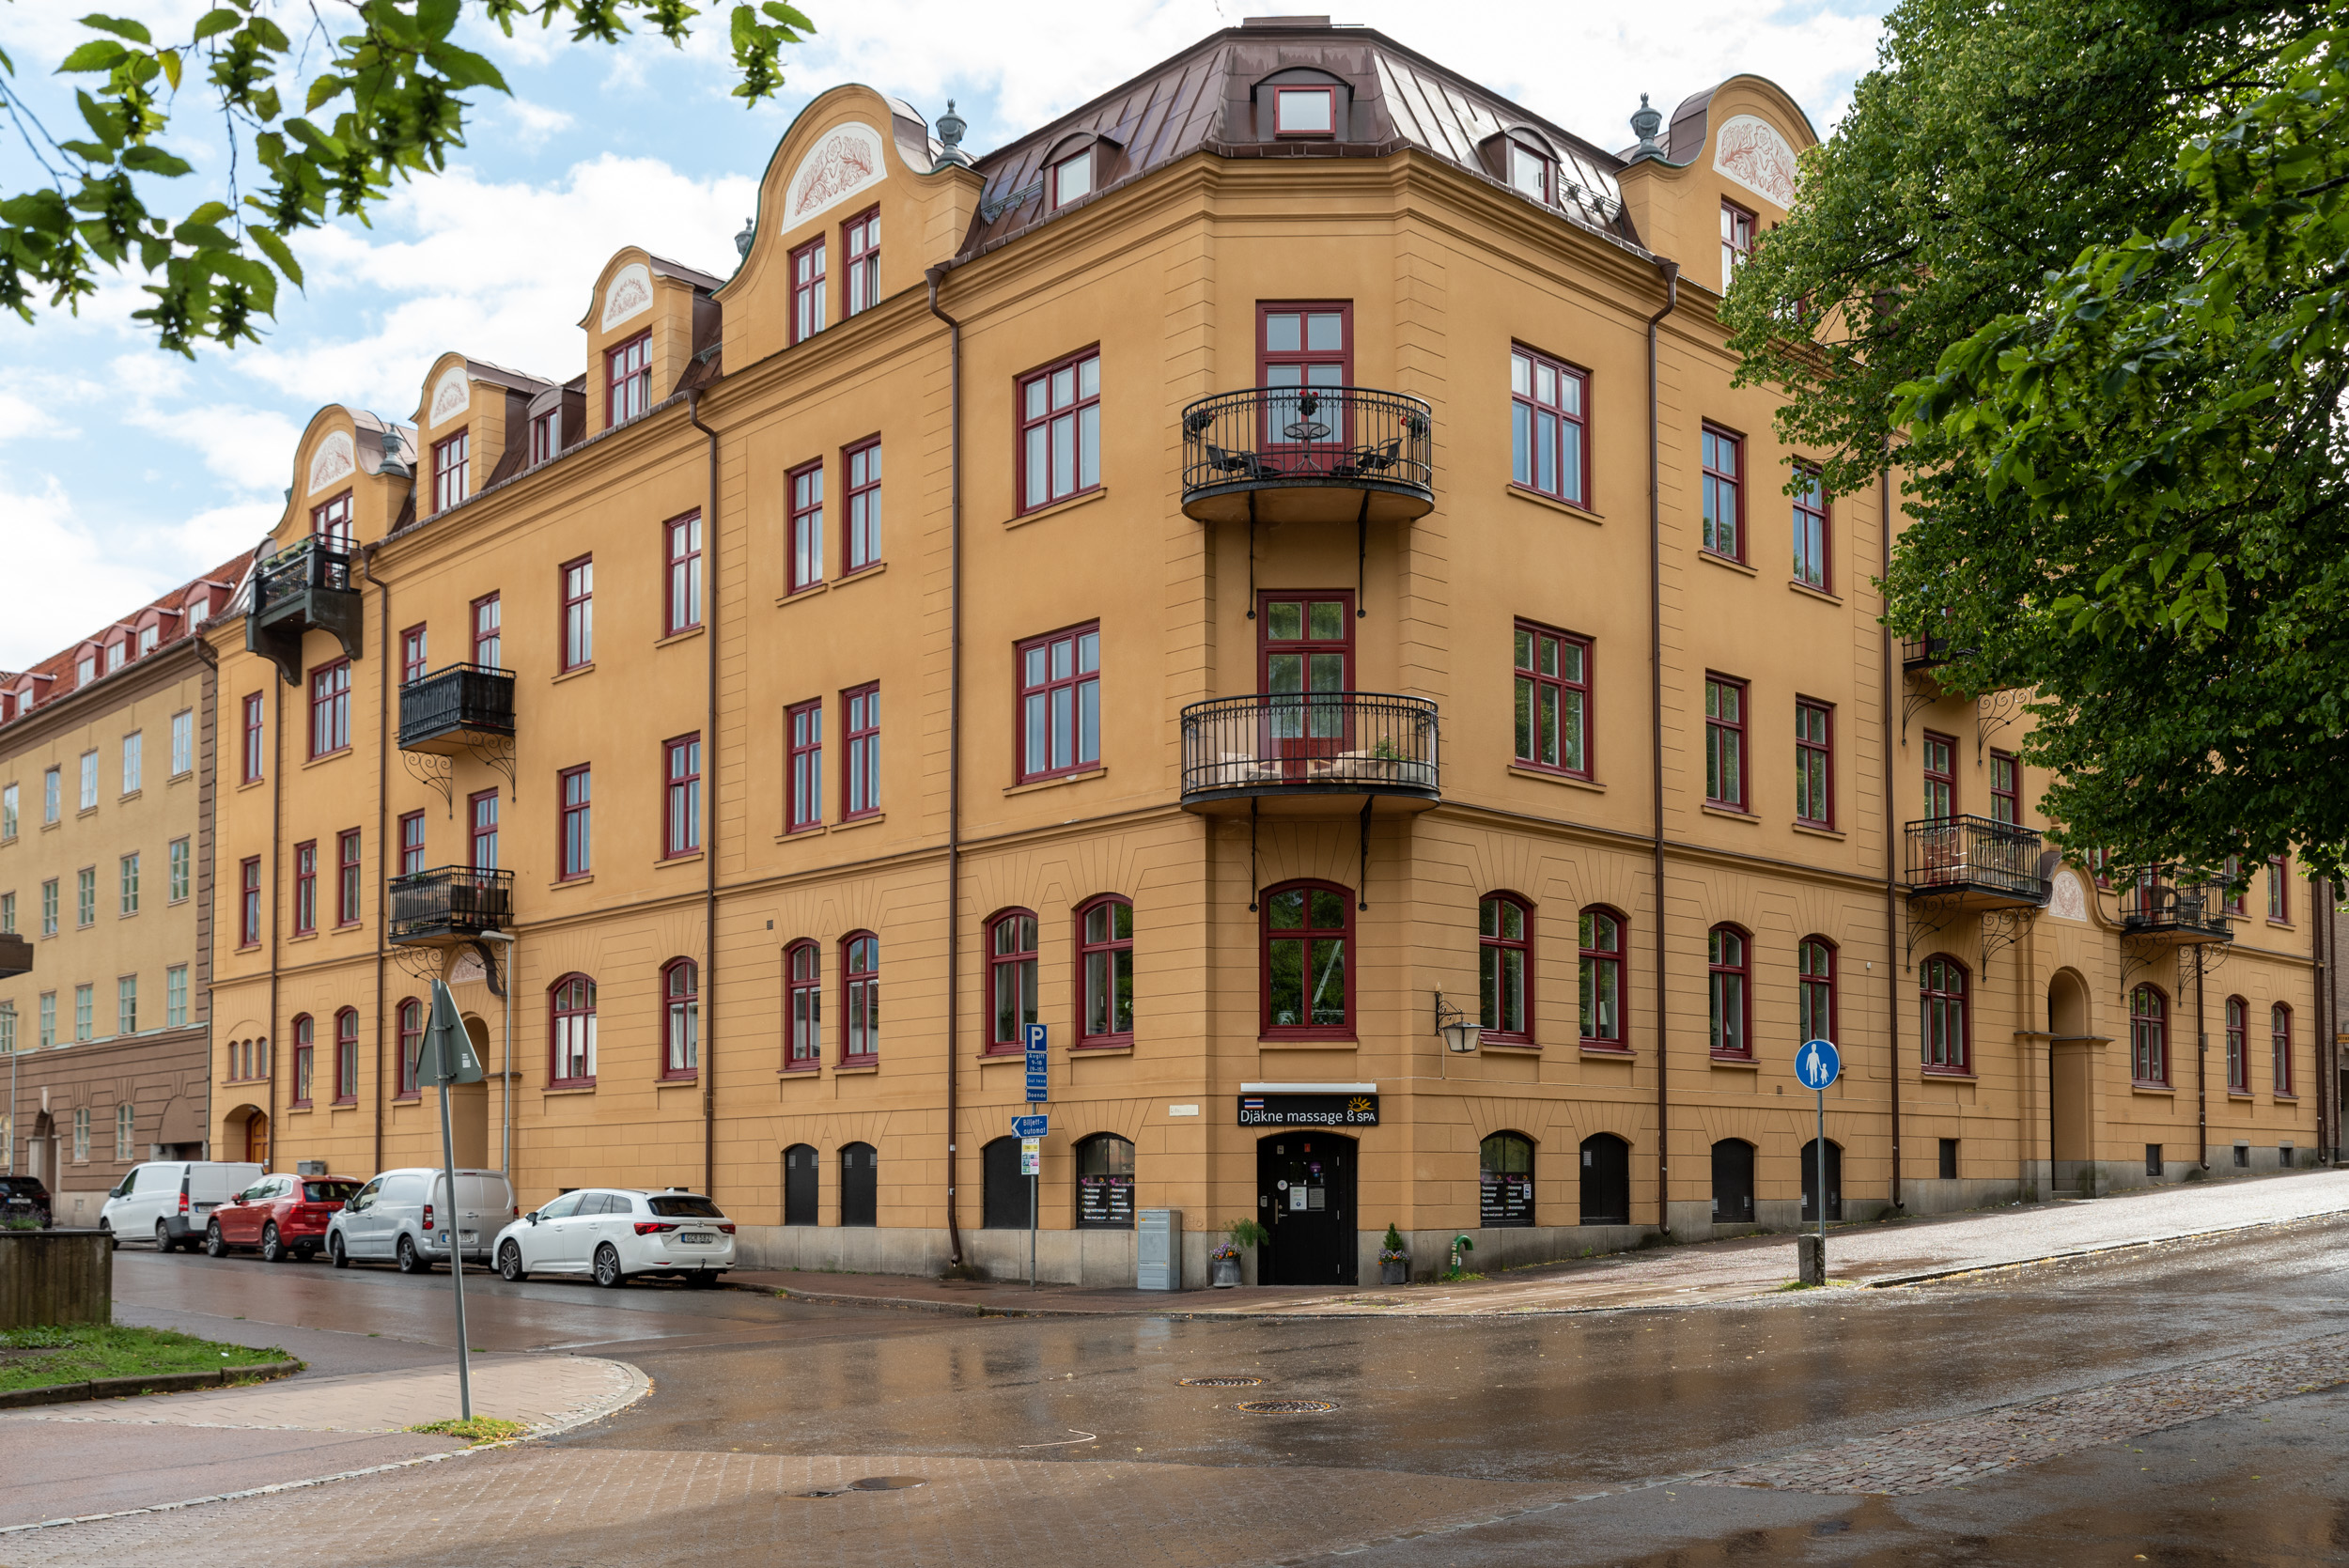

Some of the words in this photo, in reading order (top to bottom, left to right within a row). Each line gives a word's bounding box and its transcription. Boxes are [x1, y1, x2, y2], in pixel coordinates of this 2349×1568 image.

[1031, 1026, 1044, 1049] P
[1023, 1118, 1043, 1126] Biljett-
[1240, 1110, 1283, 1125] Djäkne
[1286, 1112, 1343, 1125] massage
[1346, 1110, 1355, 1122] &
[1357, 1112, 1376, 1122] SPA
[1023, 1126, 1046, 1135] automat
